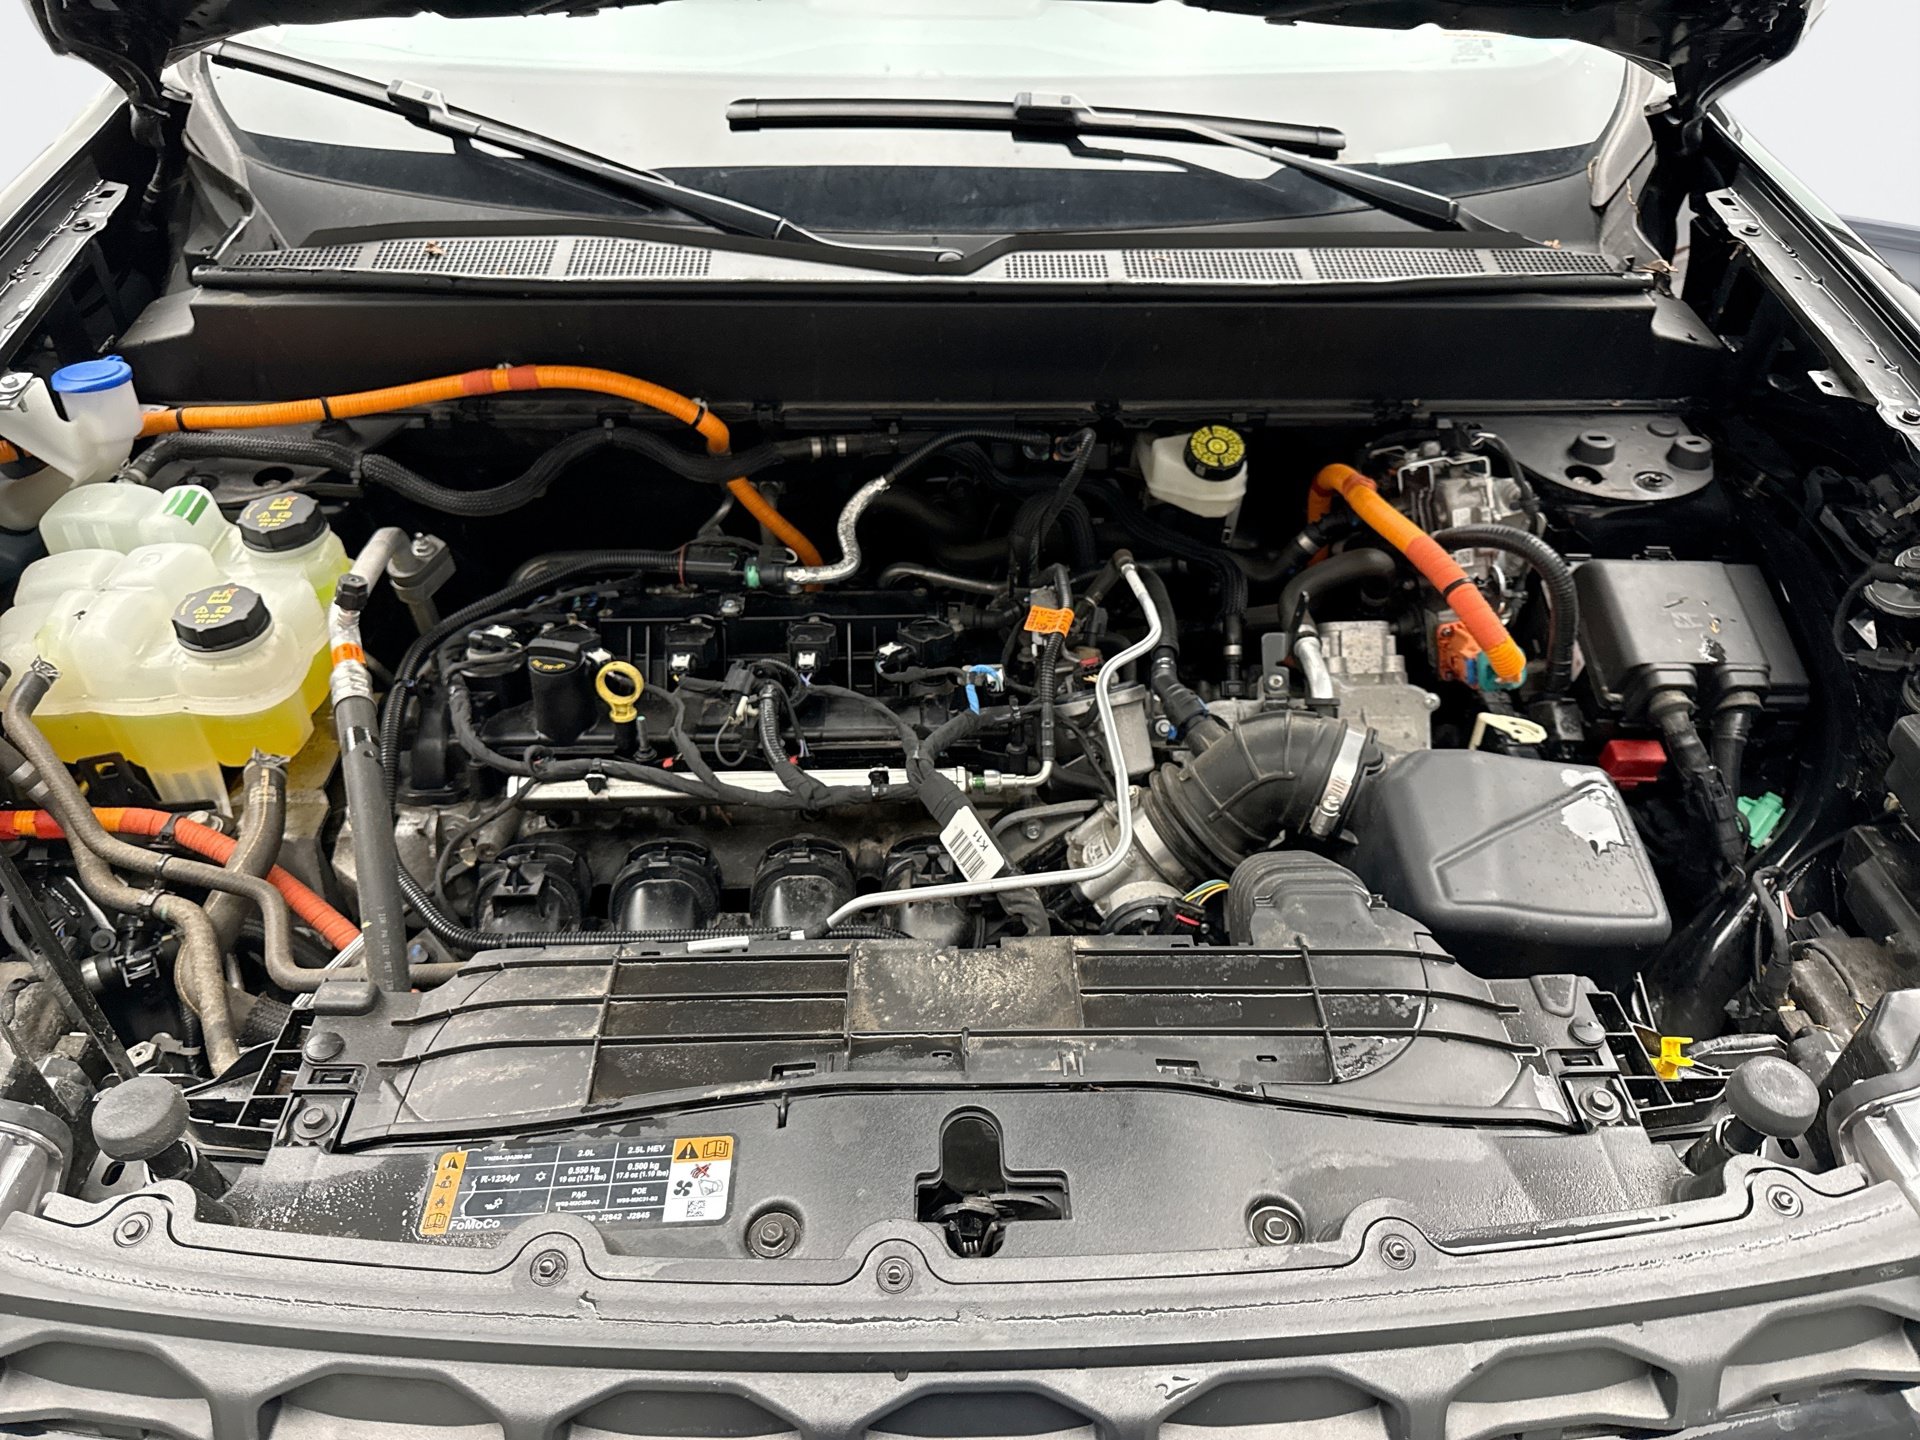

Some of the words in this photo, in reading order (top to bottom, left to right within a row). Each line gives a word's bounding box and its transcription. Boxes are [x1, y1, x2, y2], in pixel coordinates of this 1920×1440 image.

[972, 829, 989, 852] K11
[577, 1149, 596, 1157] 2.0L
[627, 1146, 646, 1154] 2.5L
[646, 1144, 666, 1154] HEV
[568, 1166, 590, 1175] 0.550
[590, 1165, 601, 1175] kg
[627, 1162, 649, 1171] 0.500
[649, 1161, 660, 1171] kg
[480, 1173, 521, 1184] R-1234yf
[631, 1187, 648, 1195] POE
[449, 1218, 501, 1231] FoMoCo
